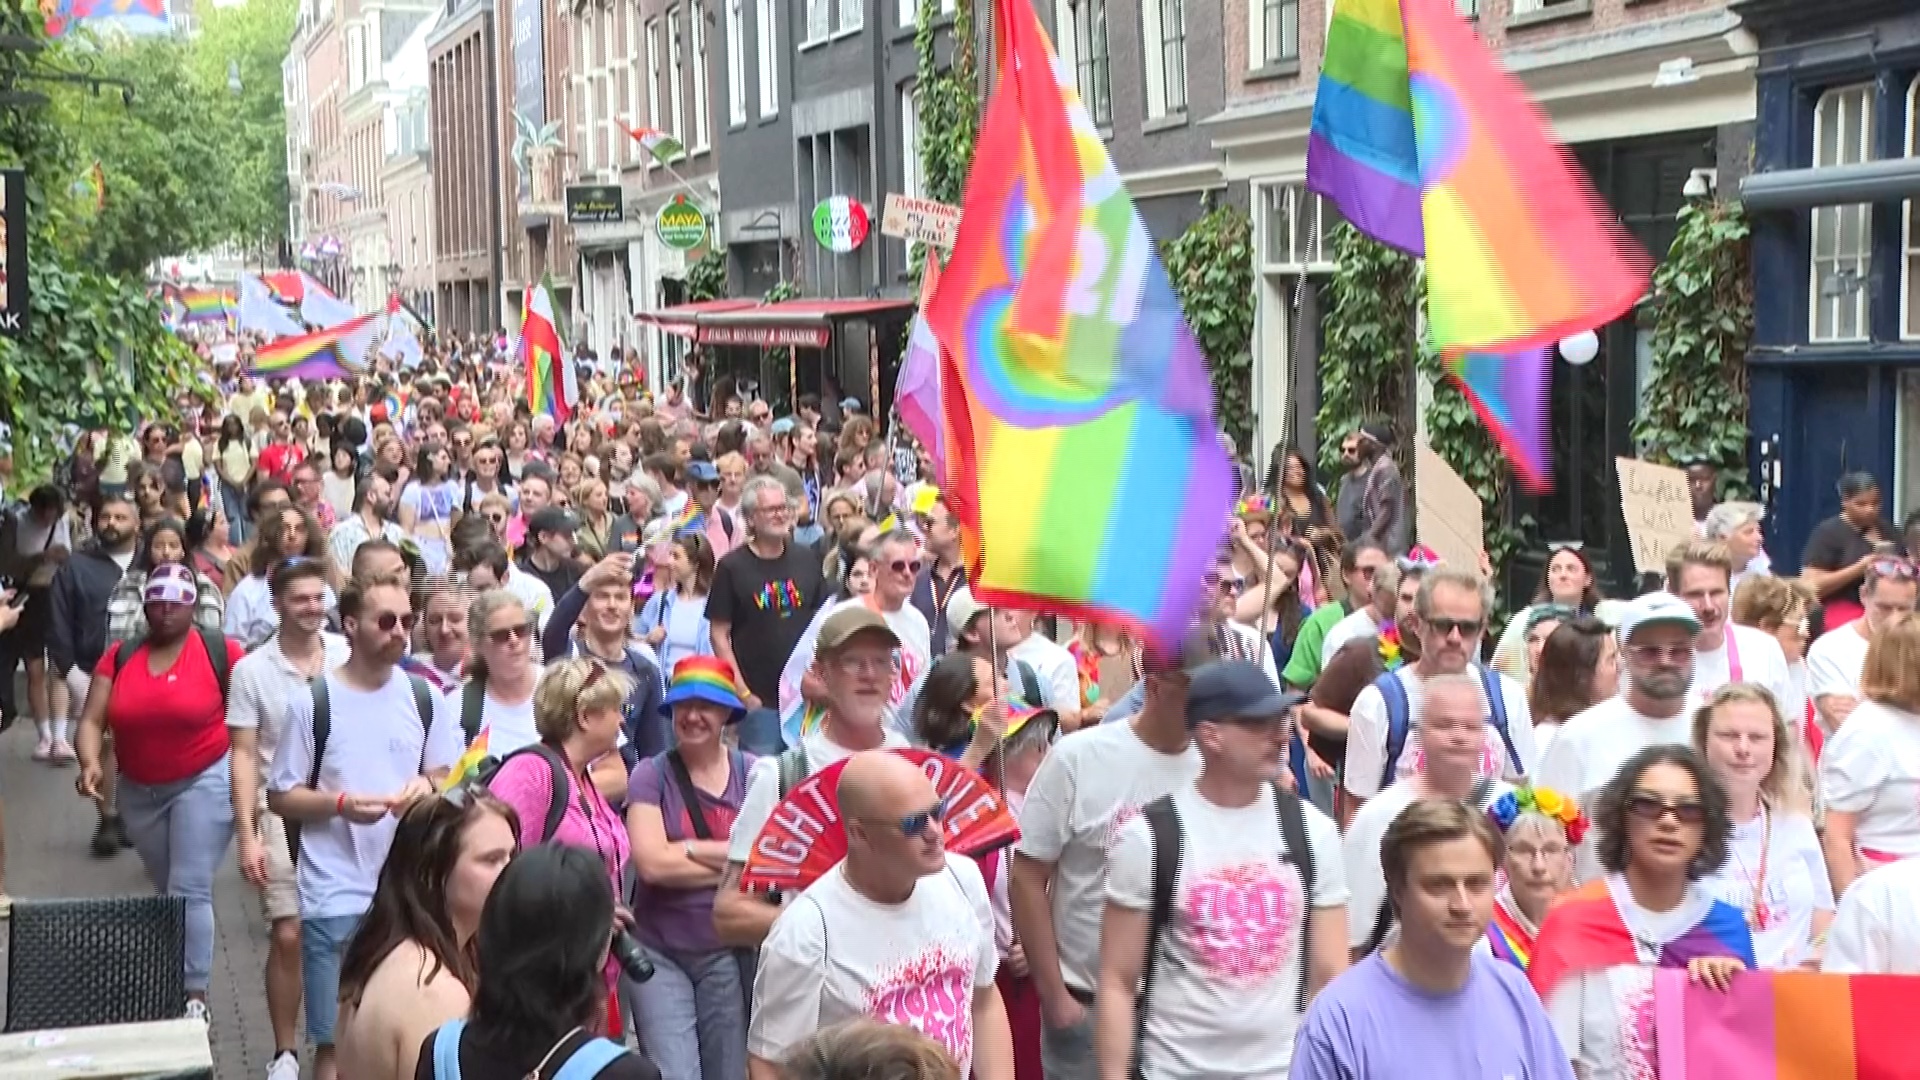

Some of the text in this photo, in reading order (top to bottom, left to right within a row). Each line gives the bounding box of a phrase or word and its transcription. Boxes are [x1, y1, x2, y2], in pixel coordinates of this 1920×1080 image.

[660, 212, 703, 228] MAYA
[821, 216, 861, 228] PIZZA
[820, 229, 862, 240] PASTA
[744, 757, 998, 893] IGHT OVE
